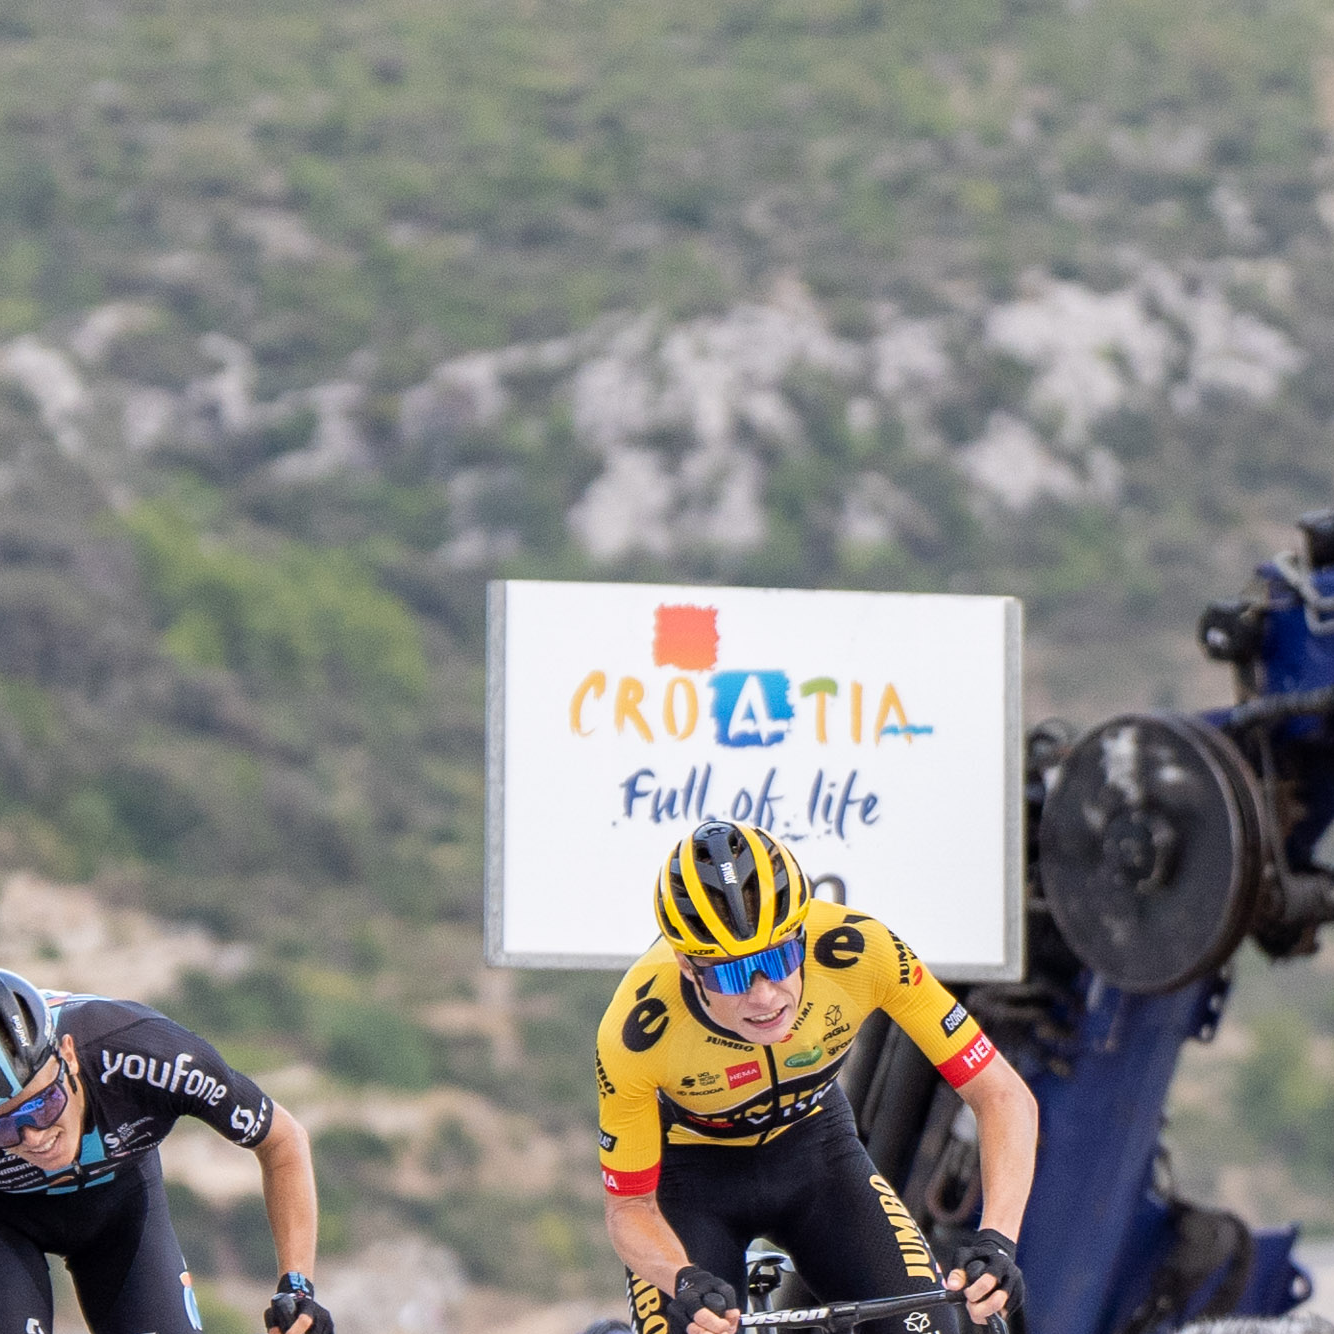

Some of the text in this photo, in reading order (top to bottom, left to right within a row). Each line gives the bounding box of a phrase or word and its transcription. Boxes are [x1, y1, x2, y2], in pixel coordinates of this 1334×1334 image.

[569, 669, 933, 747] CROATIA
[620, 763, 880, 838] Full of life
[792, 1002, 814, 1031] VISMA
[705, 1036, 755, 1052] JUMBO
[823, 1023, 850, 1042] AGU
[101, 1050, 228, 1107] youfone
[729, 1068, 758, 1082] HEMA
[869, 1174, 936, 1284] JUMBO
[741, 1308, 829, 1326] vision
